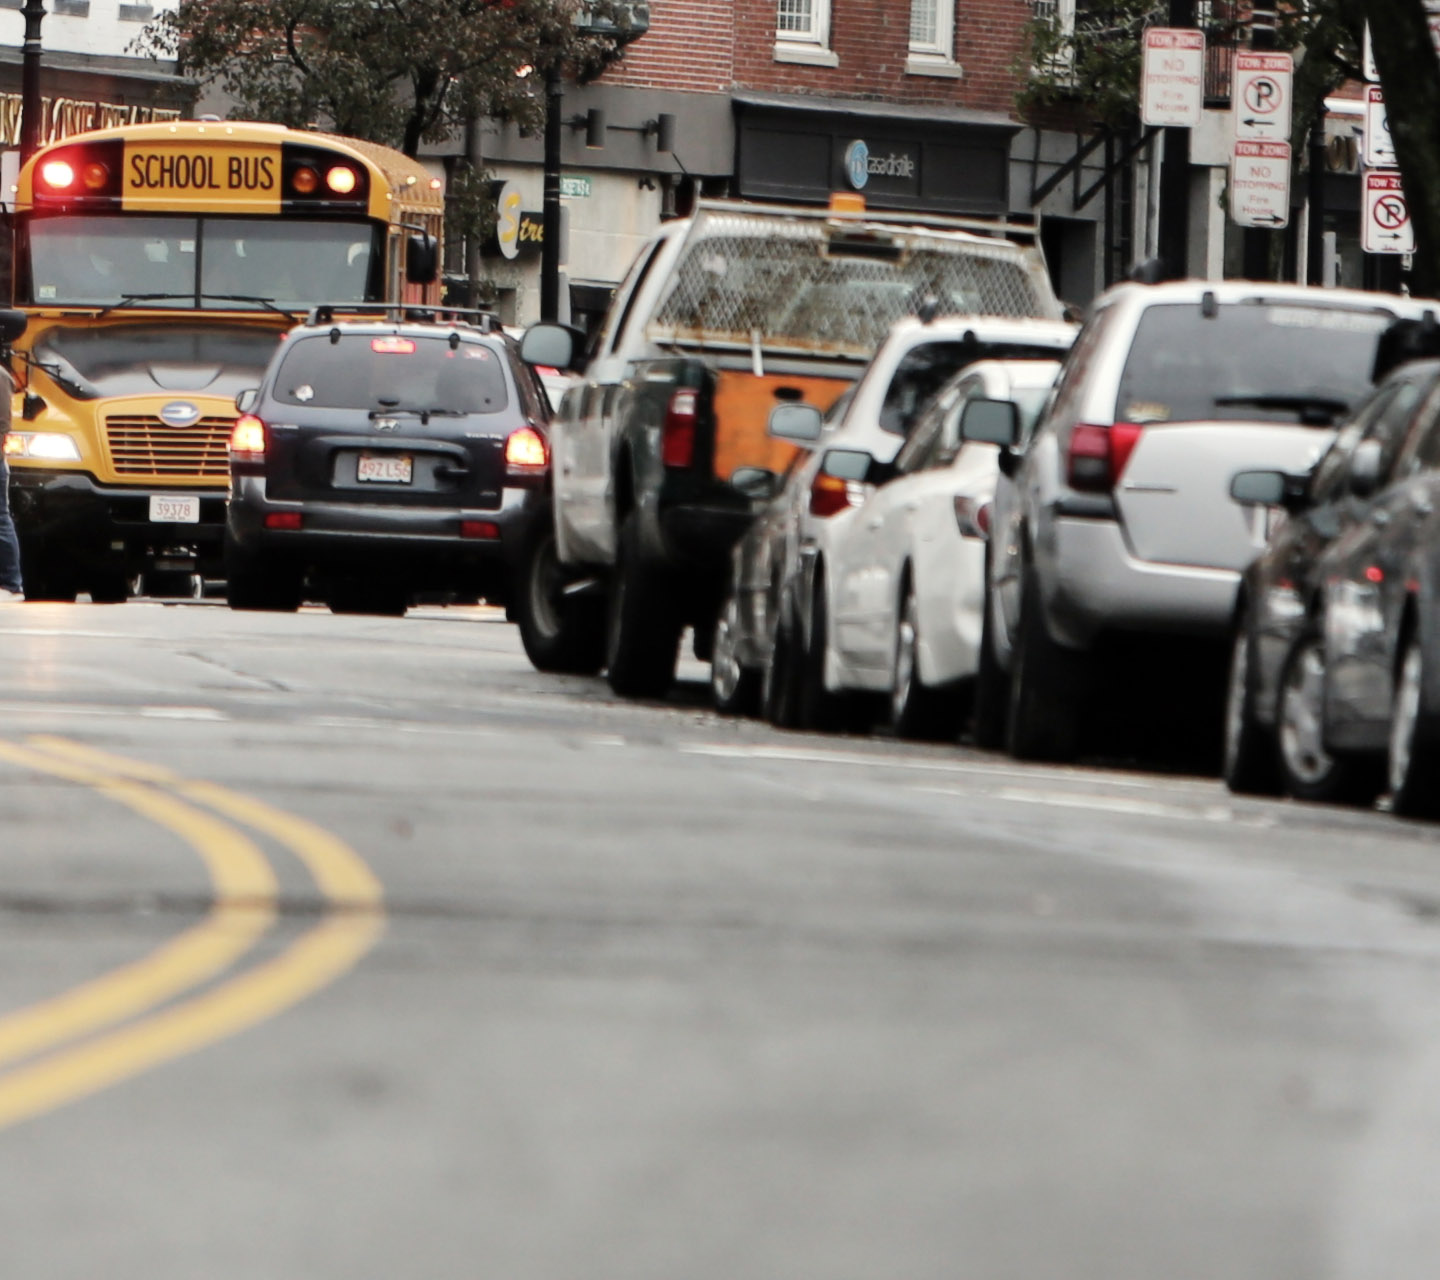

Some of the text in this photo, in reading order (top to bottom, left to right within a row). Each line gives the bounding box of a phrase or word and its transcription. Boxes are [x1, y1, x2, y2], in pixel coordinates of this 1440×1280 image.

[1150, 35, 1202, 48] TOW ZONE
[1162, 59, 1184, 72] NO
[1238, 58, 1290, 71] TOW ZONE
[1148, 74, 1200, 85] STOPPING
[1155, 103, 1190, 113] House
[1237, 144, 1289, 156] TOW ZONE
[130, 154, 274, 190] SCHOOL BUS
[1250, 166, 1272, 178] NO
[1233, 180, 1286, 191] STOPPING
[1368, 178, 1388, 189] TOW
